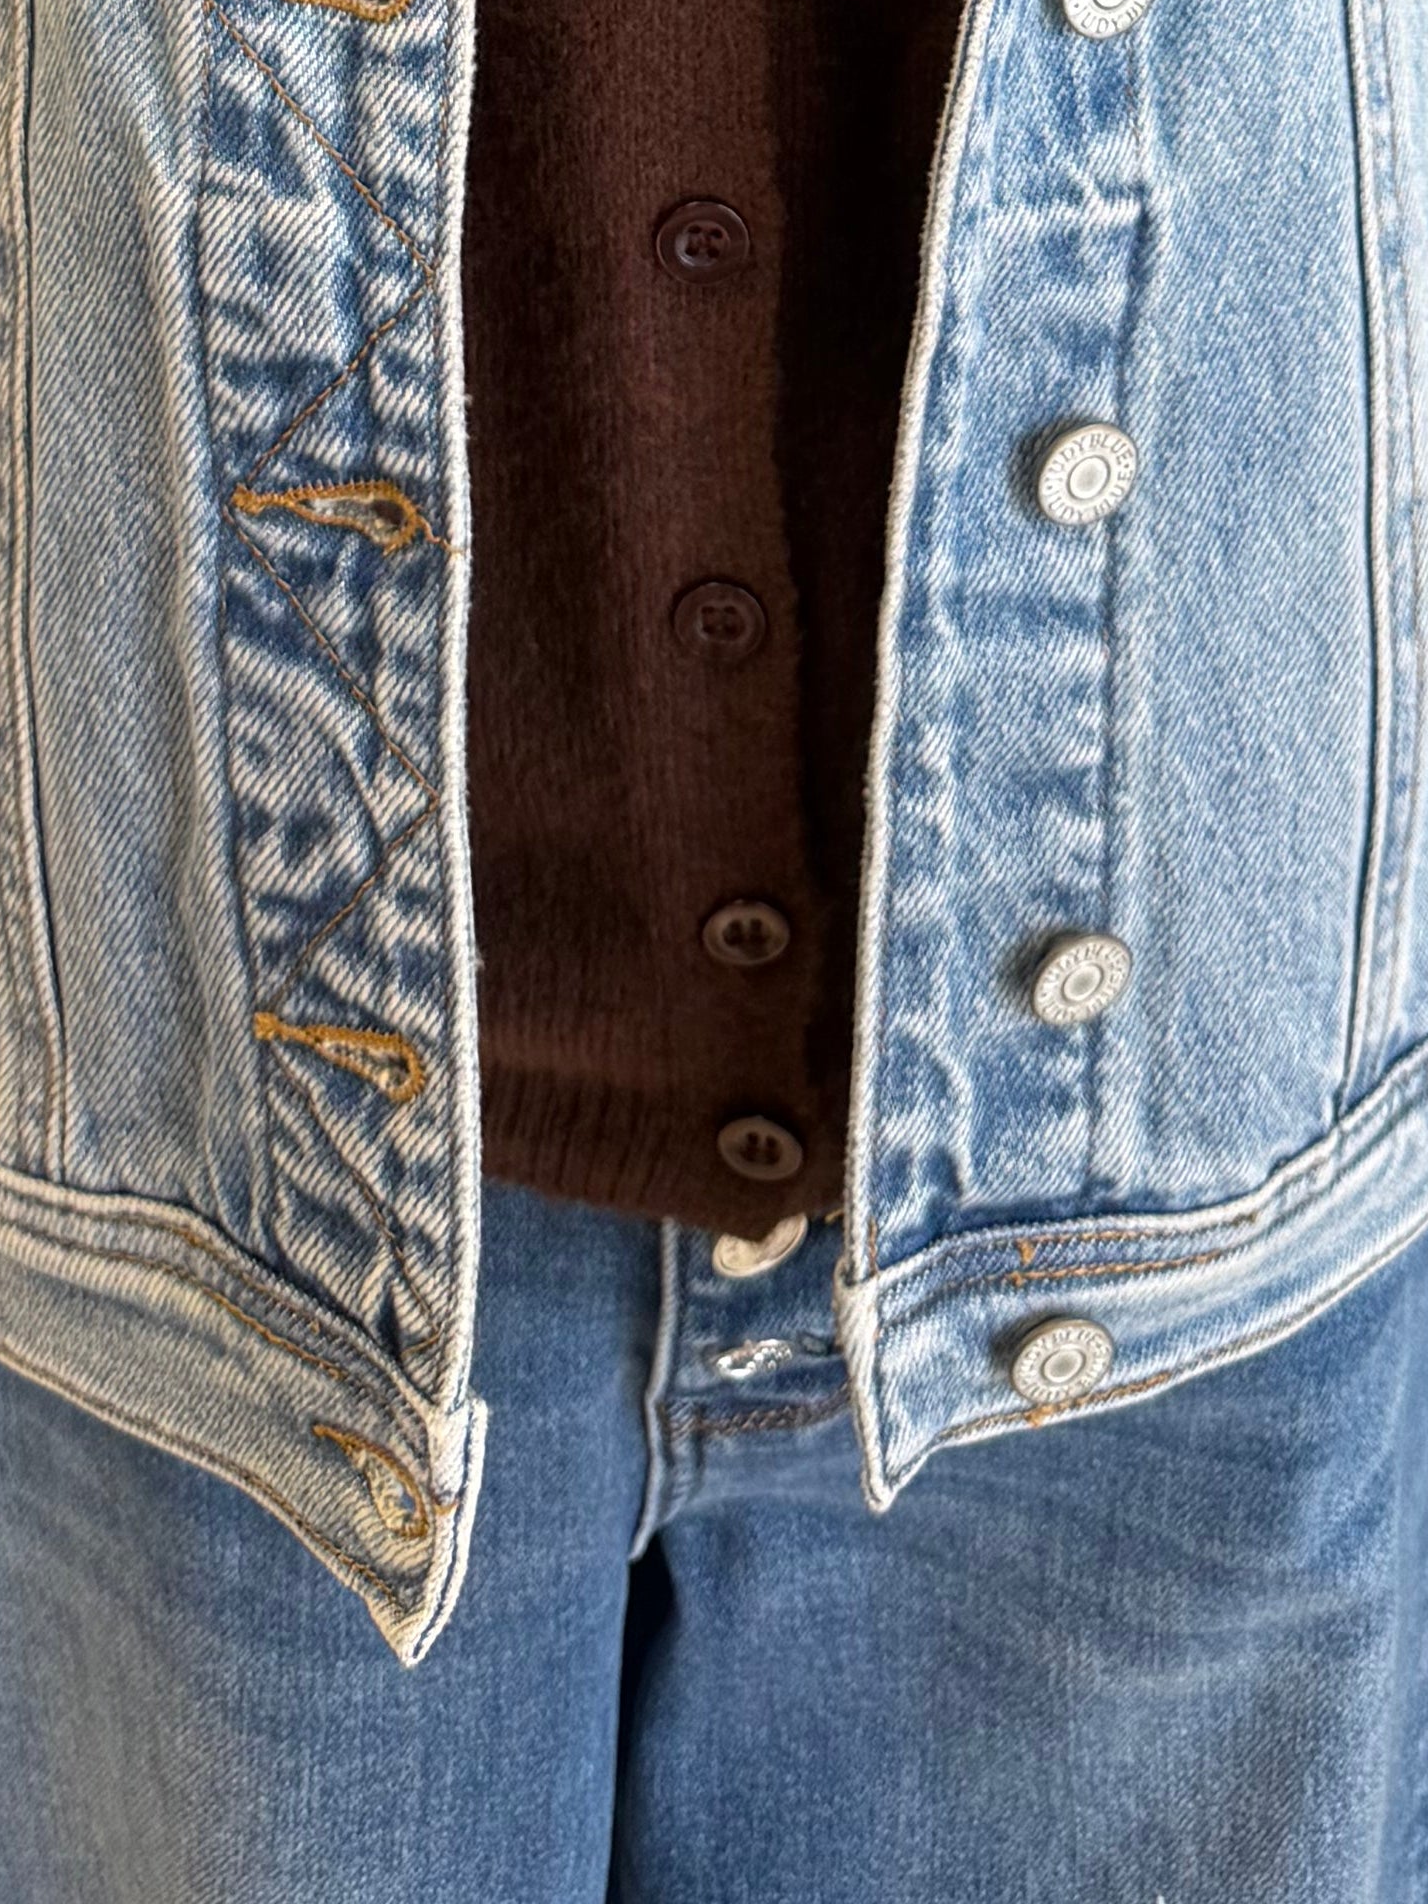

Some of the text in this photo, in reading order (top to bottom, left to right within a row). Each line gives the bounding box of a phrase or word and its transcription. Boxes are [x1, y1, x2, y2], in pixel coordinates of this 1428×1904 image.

[1072, 5, 1122, 34] JUDY
[1043, 433, 1134, 483] JUDY BLUE
